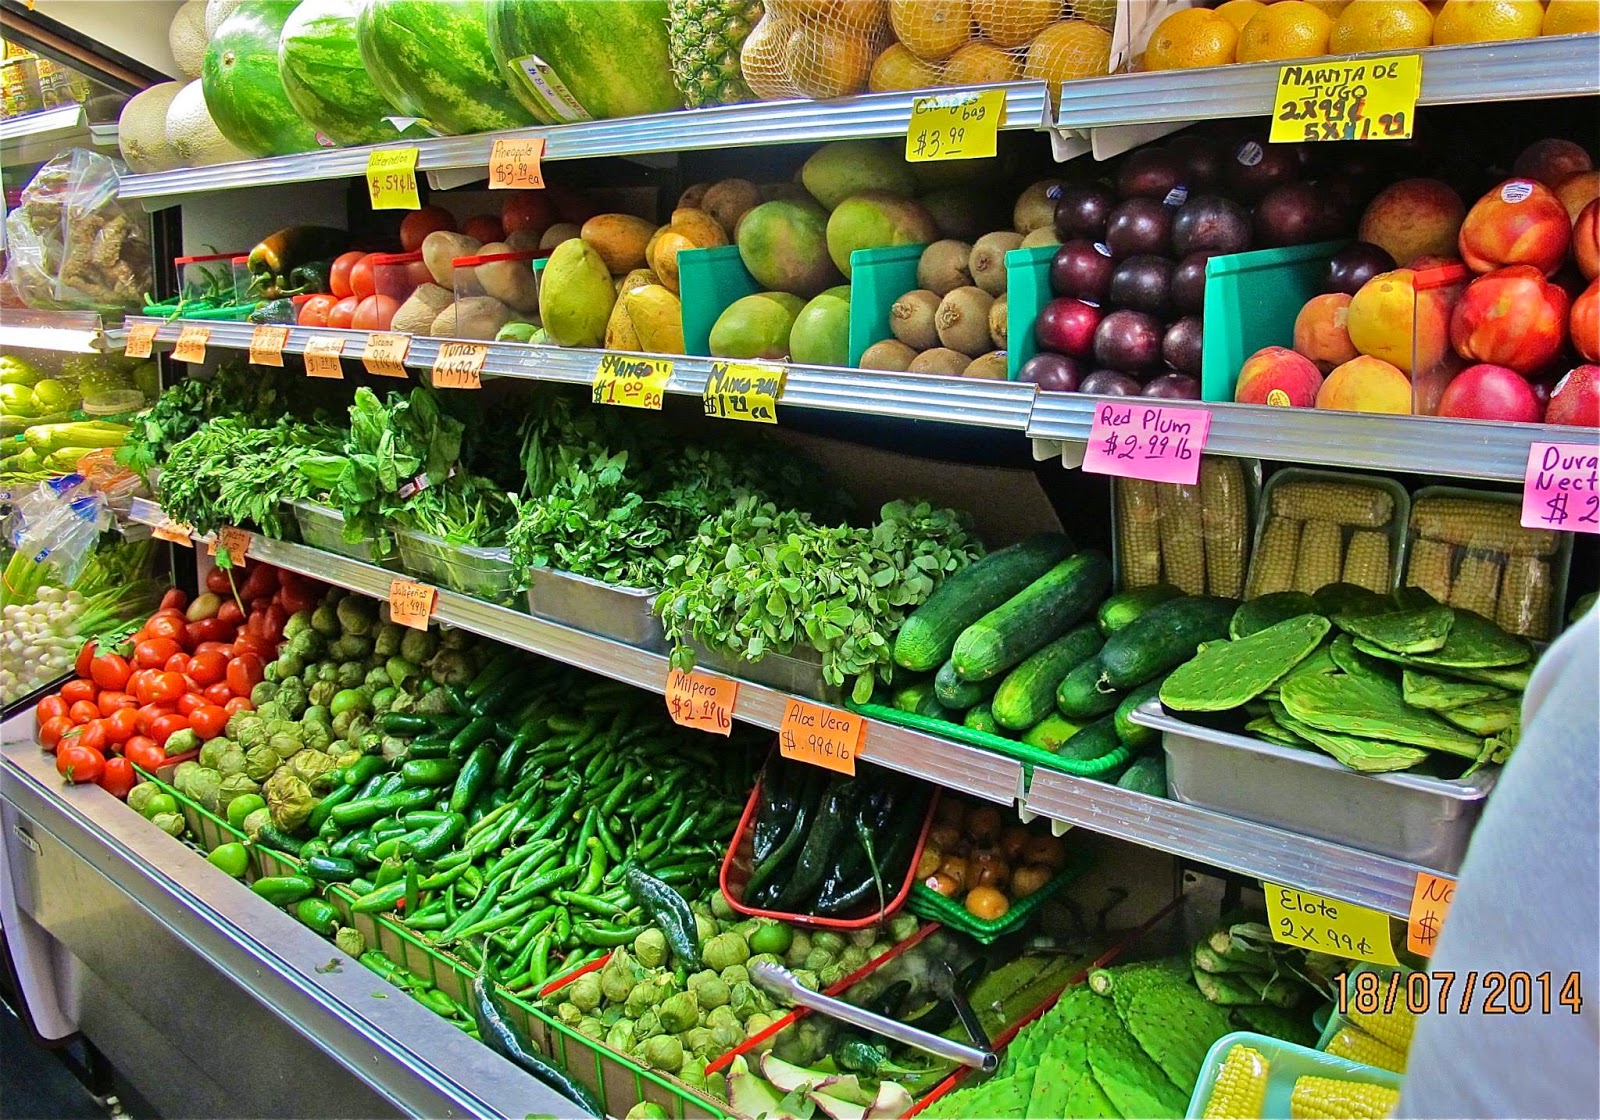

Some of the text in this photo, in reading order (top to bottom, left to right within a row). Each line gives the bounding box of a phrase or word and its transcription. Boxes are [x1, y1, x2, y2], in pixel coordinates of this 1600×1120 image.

[1373, 62, 1398, 79] DE
[1299, 85, 1368, 101] JUGO
[962, 106, 986, 121] bag
[912, 126, 965, 157] $3.99
[443, 344, 477, 359] Tunas
[1101, 406, 1191, 434] Red Plum
[1102, 432, 1192, 460] $2.99 lb
[1543, 446, 1598, 471] Dura
[1535, 471, 1598, 490] Nect
[674, 674, 716, 698] Milpero
[788, 704, 850, 733] Aloe Vera
[1280, 890, 1337, 920] Elote
